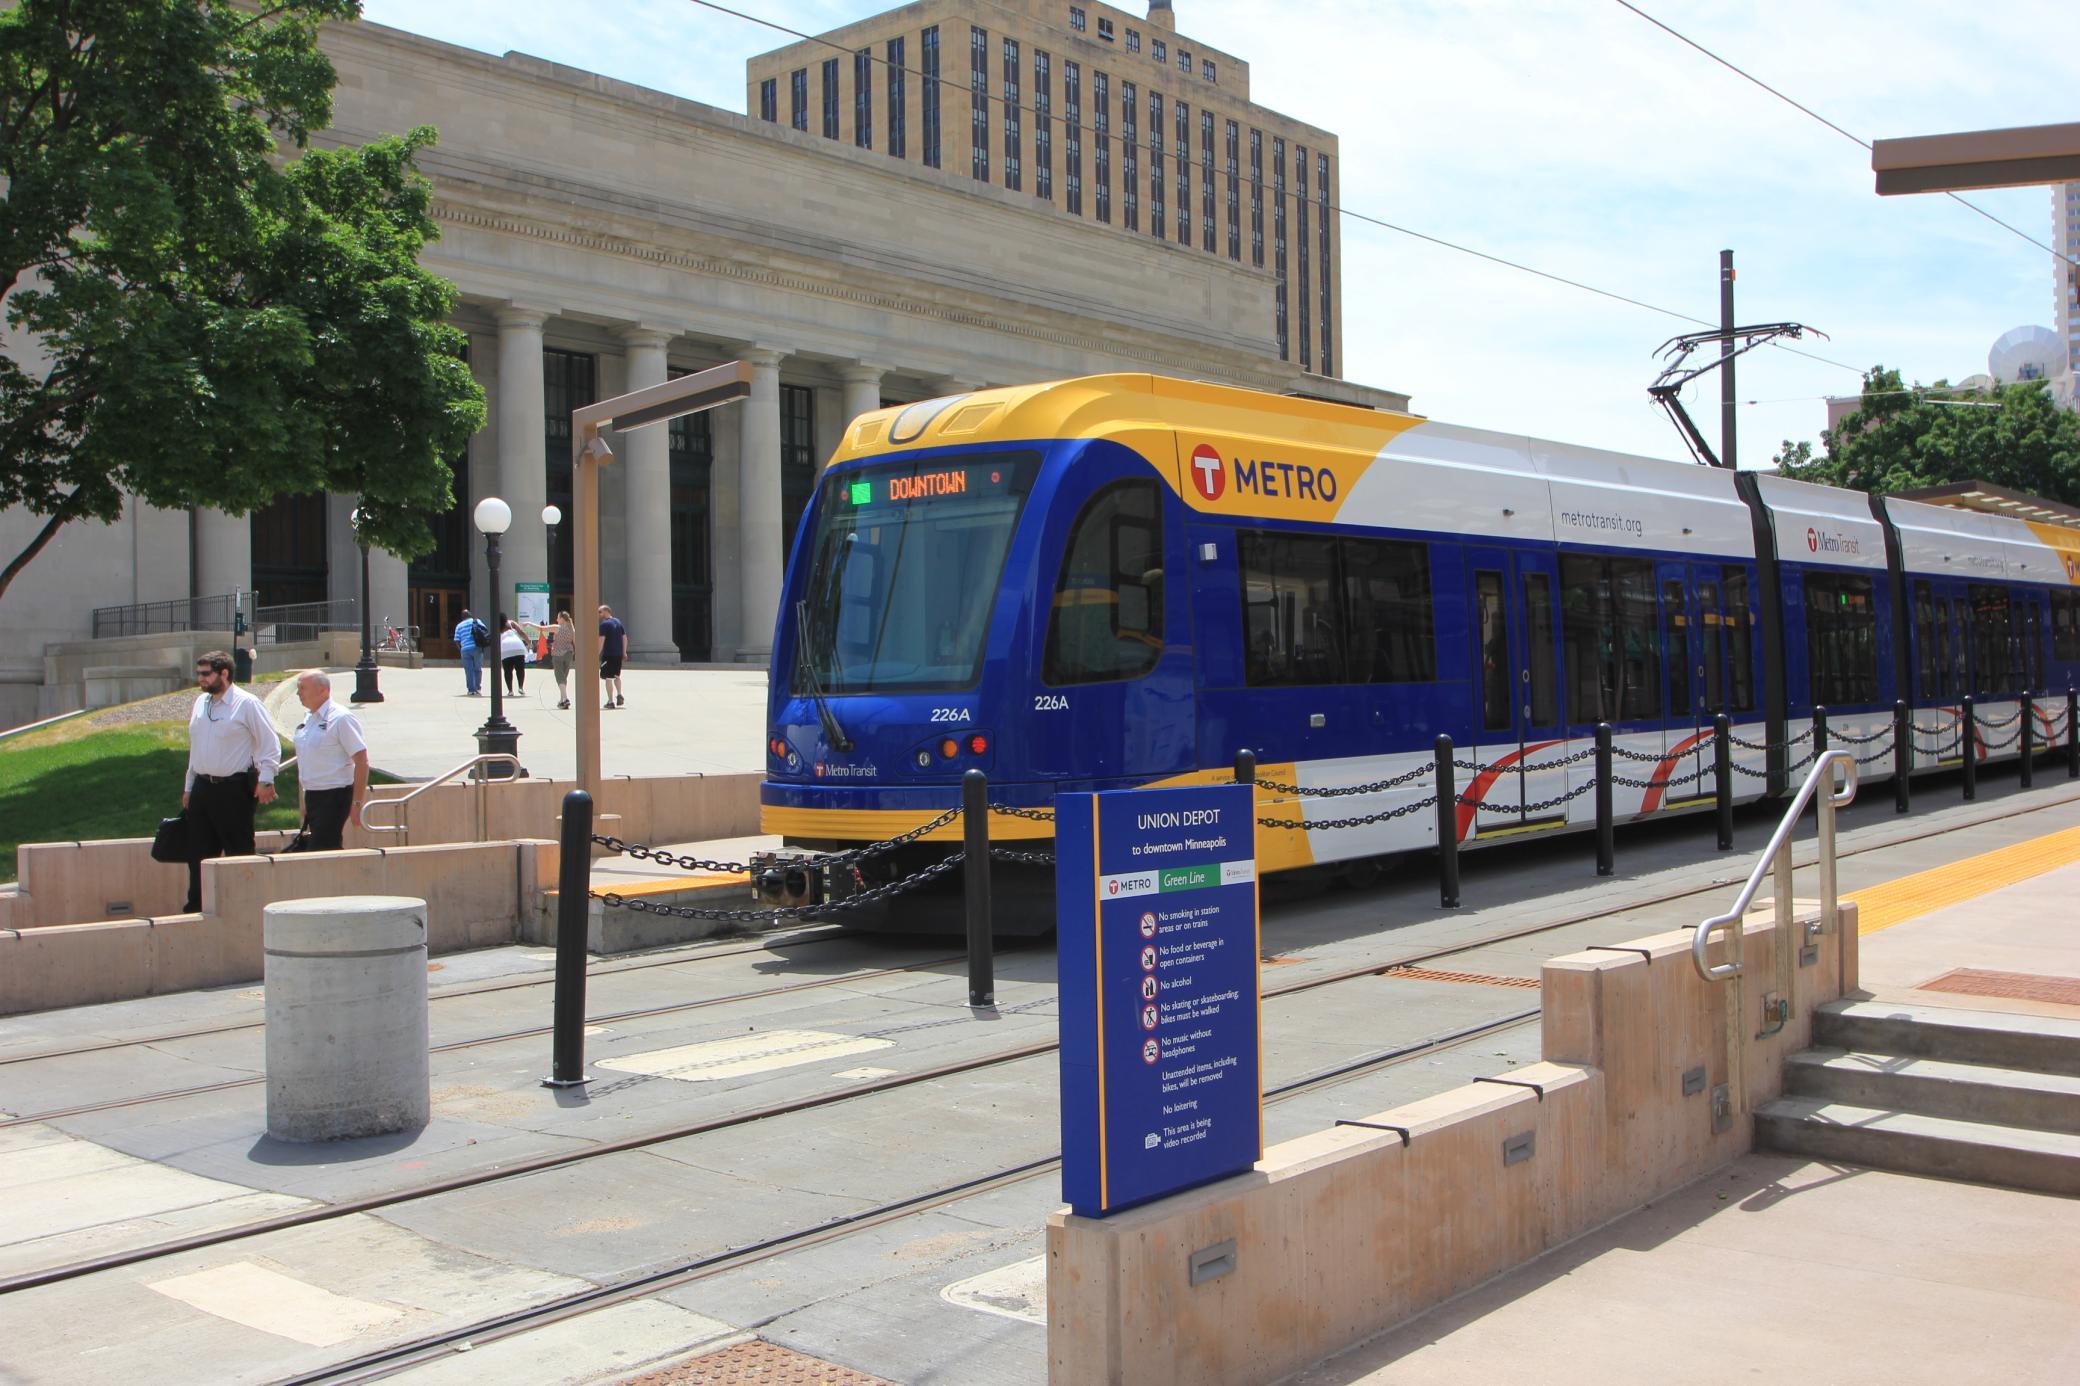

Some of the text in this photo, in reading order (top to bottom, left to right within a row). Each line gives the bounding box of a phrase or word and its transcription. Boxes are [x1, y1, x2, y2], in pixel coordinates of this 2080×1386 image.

[889, 470, 967, 500] DOWNTOWN
[1234, 457, 1337, 502] METRO
[1561, 512, 1643, 537] metrotransit.org
[1034, 696, 1069, 710] 226A
[930, 708, 971, 722] 226A
[1138, 808, 1221, 830] UNION DEPOT
[1132, 835, 1227, 856] to downtown Minneapolis
[1120, 878, 1151, 892] METRO
[1163, 871, 1205, 887] Green Line
[1158, 905, 1220, 922] No smoking in station
[1158, 919, 1209, 934] areas or on trains
[1159, 937, 1225, 956] No food or beverage in
[1159, 953, 1205, 970] open containers
[1160, 976, 1192, 990] No alcohol
[1160, 1003, 1171, 1013] No
[1171, 999, 1192, 1010] skating
[1192, 998, 1200, 1006] or
[1160, 1004, 1220, 1025] bikes must be walked
[1161, 1029, 1212, 1047] No music without
[1161, 1044, 1196, 1059] headphones
[1162, 1065, 1196, 1081] Unattended
[1213, 1056, 1237, 1069] including
[1162, 1070, 1223, 1093] bikes, will be removed
[1163, 1100, 1198, 1115] No loitering
[1163, 1118, 1212, 1137] This area is being
[1163, 1129, 1207, 1149] video recorded
